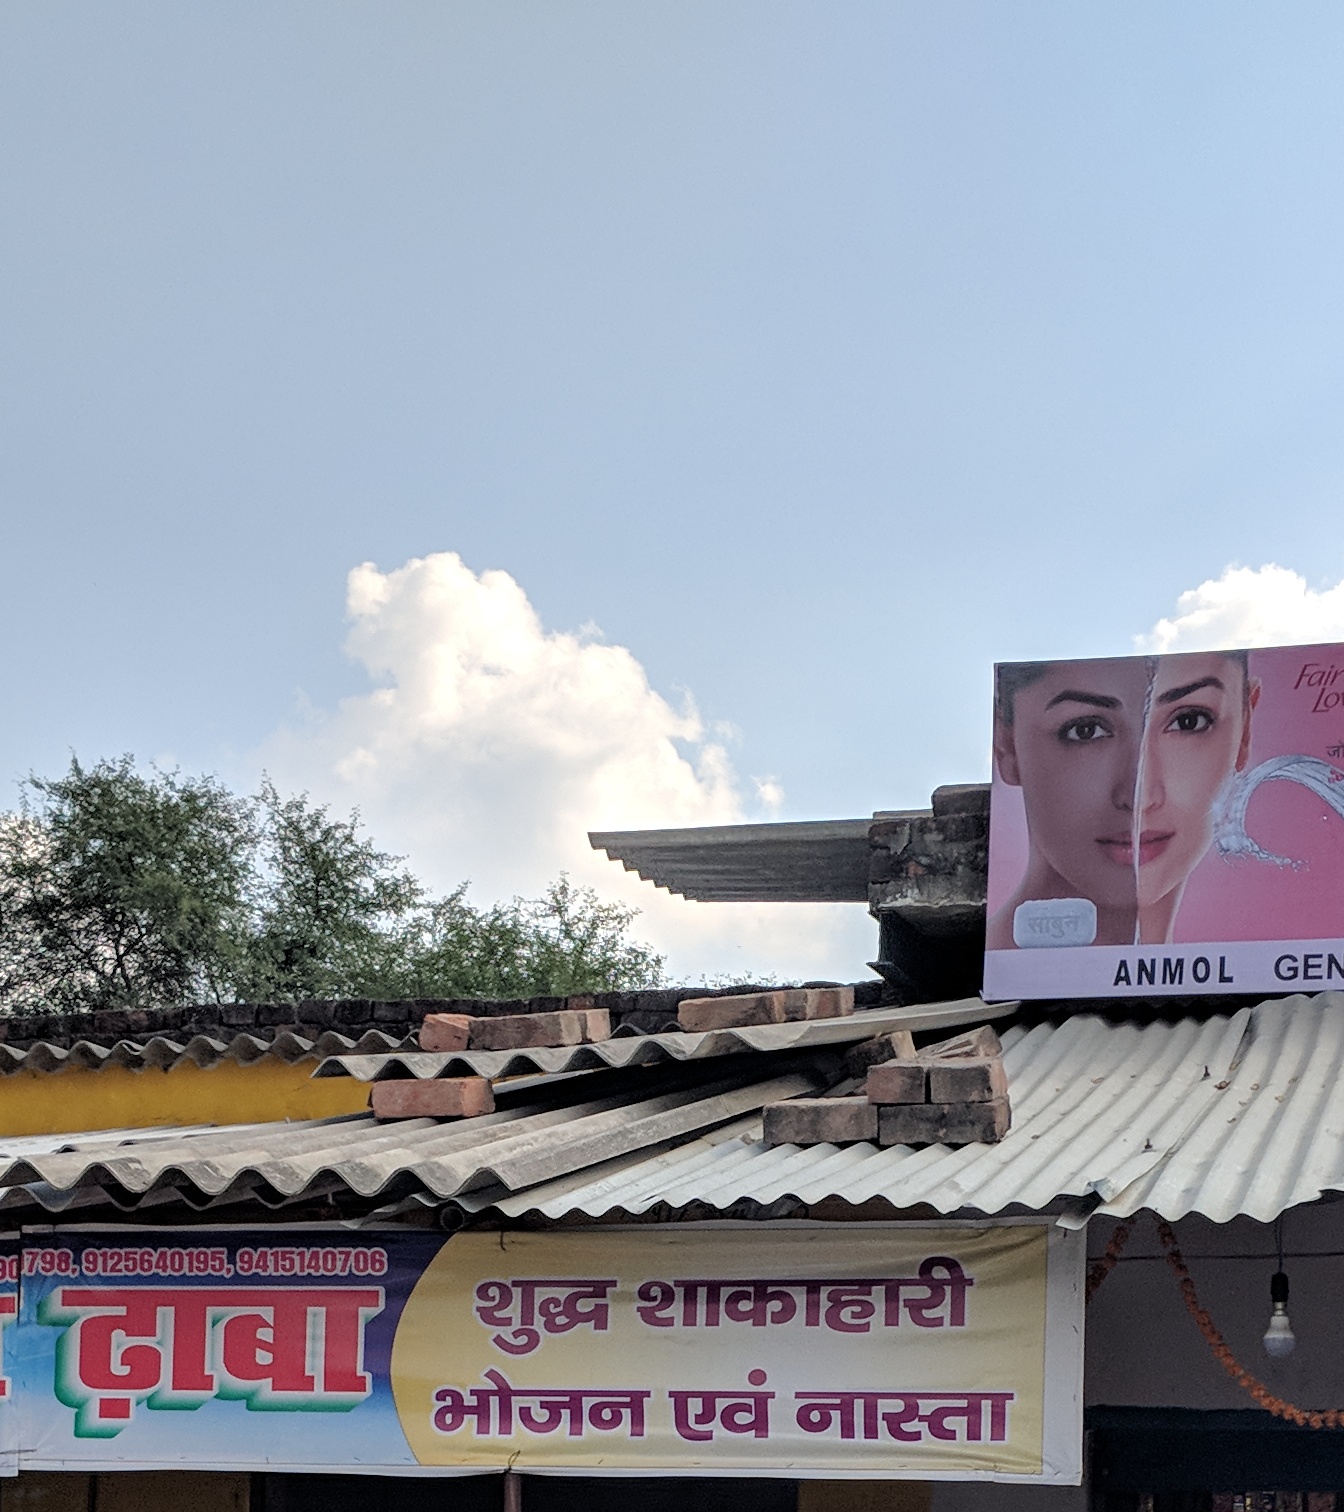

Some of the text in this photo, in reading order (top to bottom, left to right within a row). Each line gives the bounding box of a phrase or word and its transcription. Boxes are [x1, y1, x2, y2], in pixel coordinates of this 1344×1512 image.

[1113, 955, 1235, 987] ANMOL
[83, 1248, 233, 1278] 9125640195,
[237, 1247, 387, 1275] 9415140706
[475, 1256, 973, 1354] शुद्ध शाकाहारी
[432, 1368, 1014, 1442] भोजन एवं नास्ता
